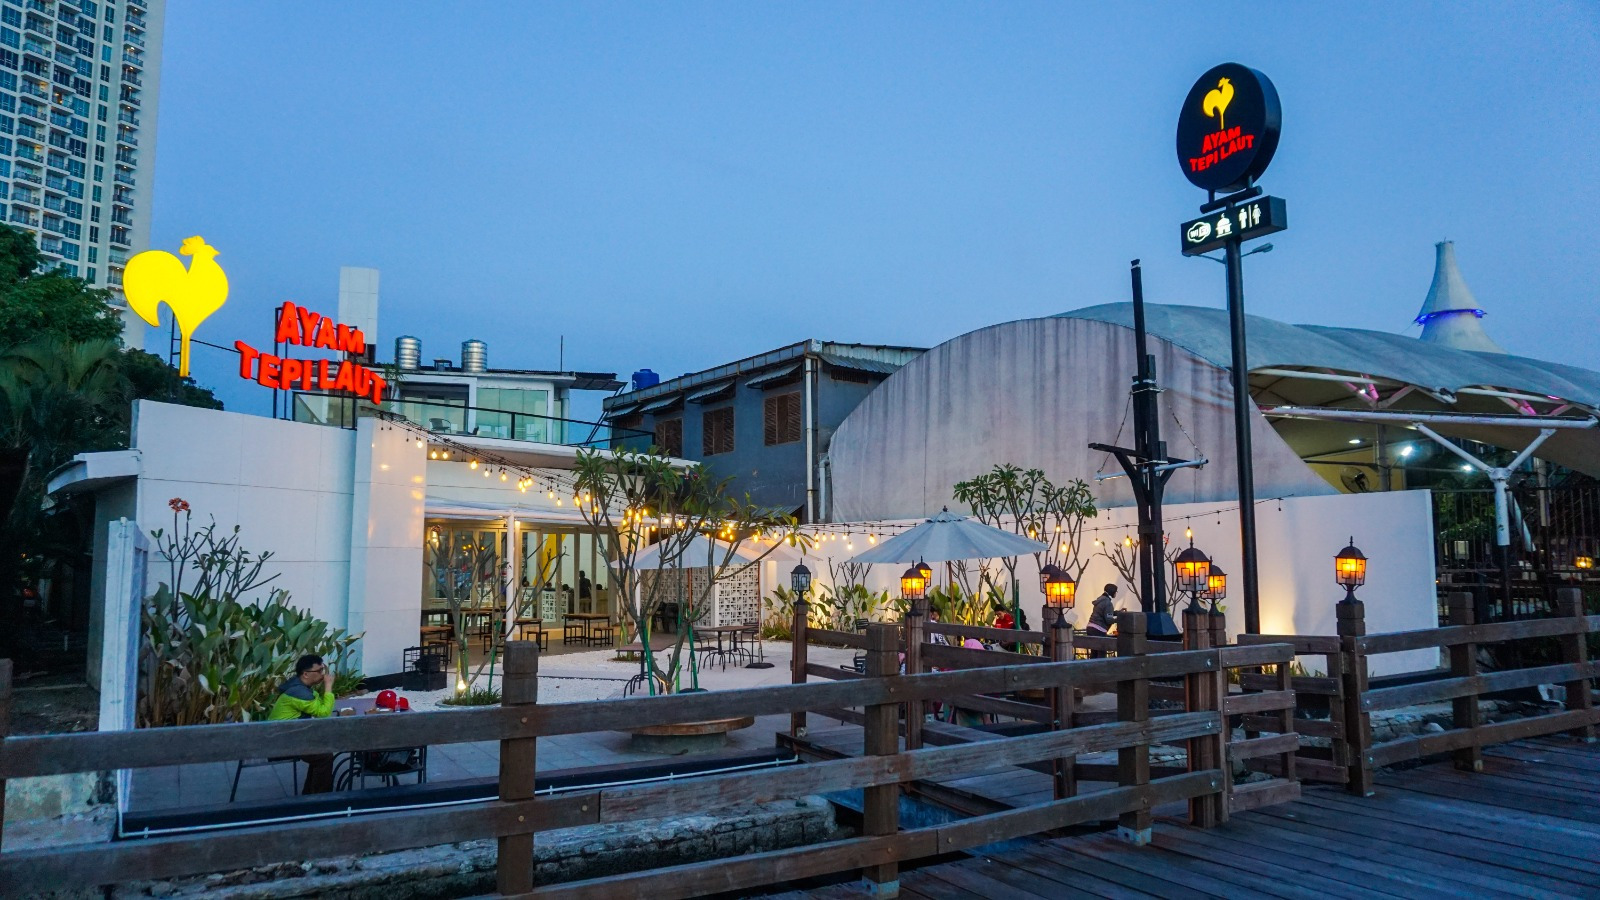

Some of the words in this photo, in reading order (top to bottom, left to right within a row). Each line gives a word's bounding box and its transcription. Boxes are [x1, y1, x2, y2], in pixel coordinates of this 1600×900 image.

[1189, 151, 1218, 172] TEPI
[1220, 135, 1254, 160] LAUT
[1202, 126, 1241, 153] AYAM
[276, 301, 364, 353] AYAM
[235, 340, 312, 390] TEPI
[318, 359, 386, 405] LAUT
